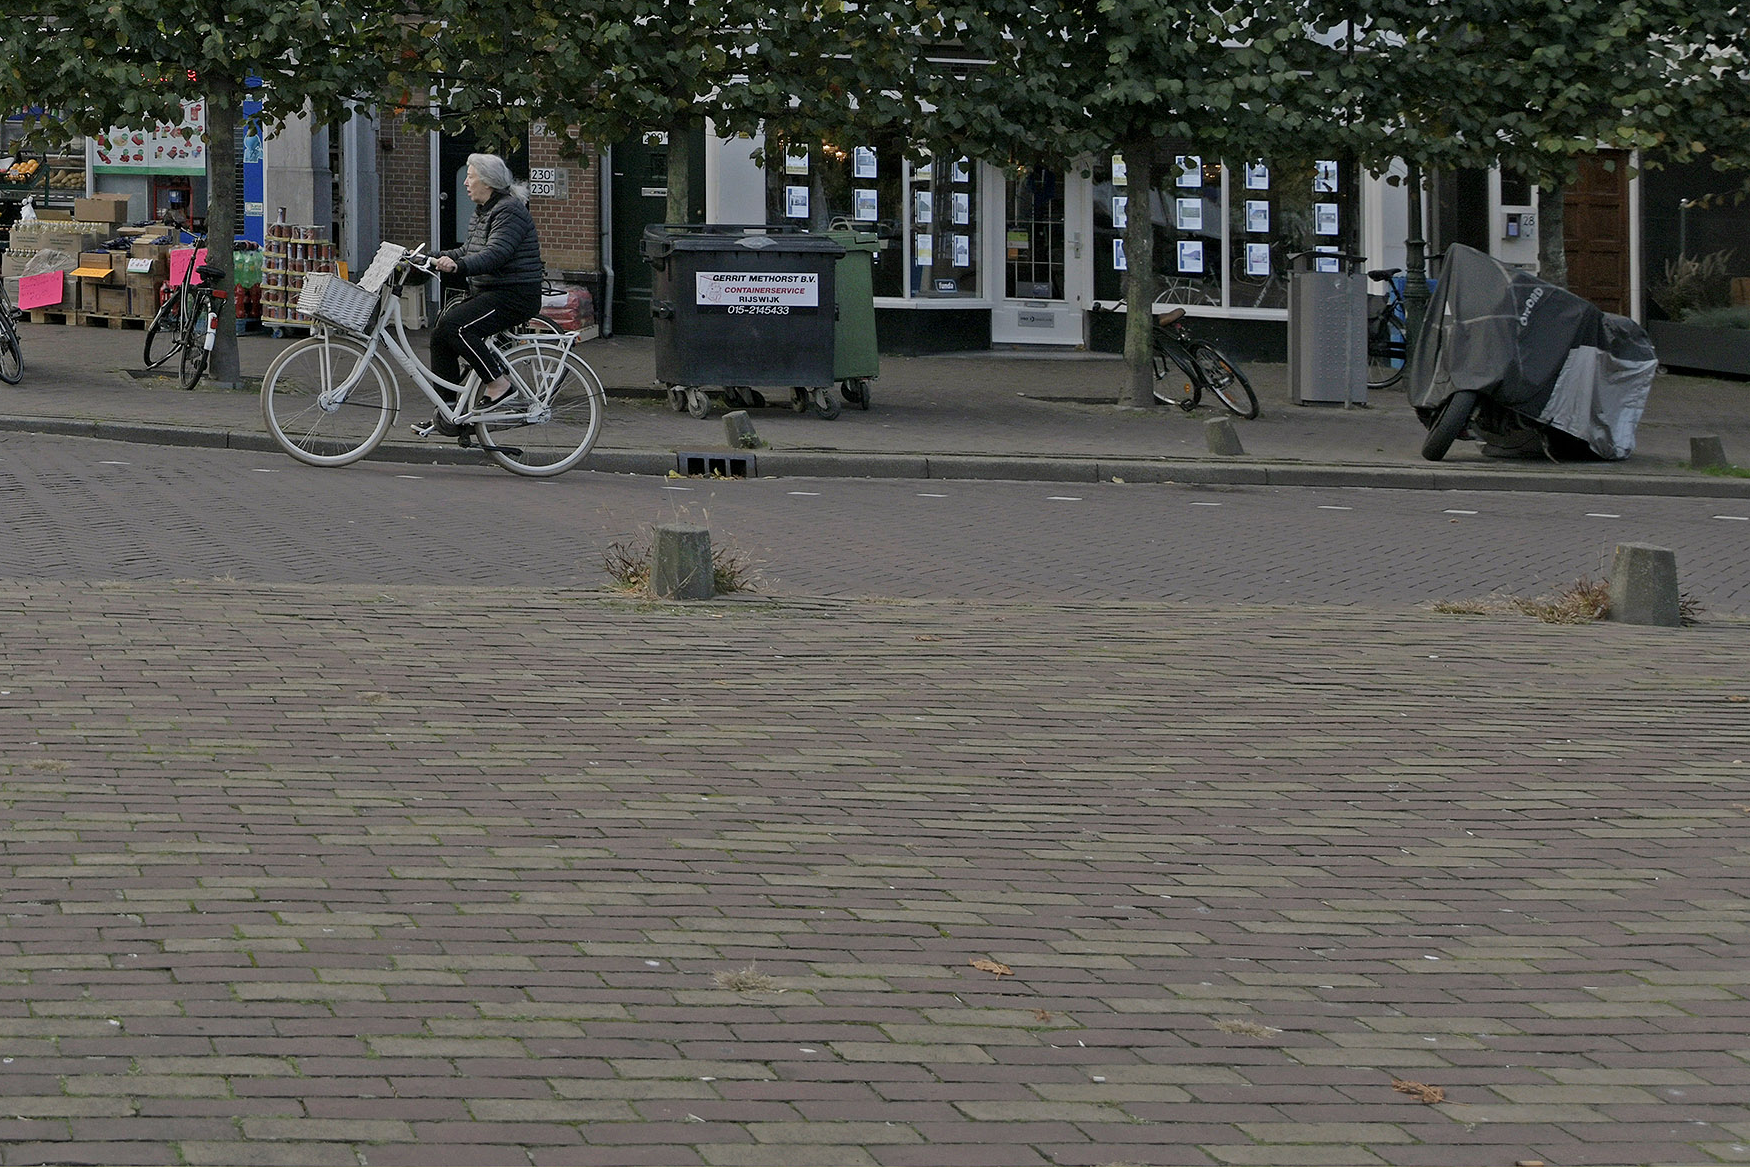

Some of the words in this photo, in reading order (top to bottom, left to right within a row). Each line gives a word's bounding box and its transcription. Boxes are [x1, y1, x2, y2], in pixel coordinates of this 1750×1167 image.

[748, 275, 799, 283] METHORST
[800, 275, 816, 283] B.V.
[938, 281, 954, 290] funda
[724, 287, 806, 295] CONTAINERSERVICE
[727, 305, 790, 315] 015-2145433
